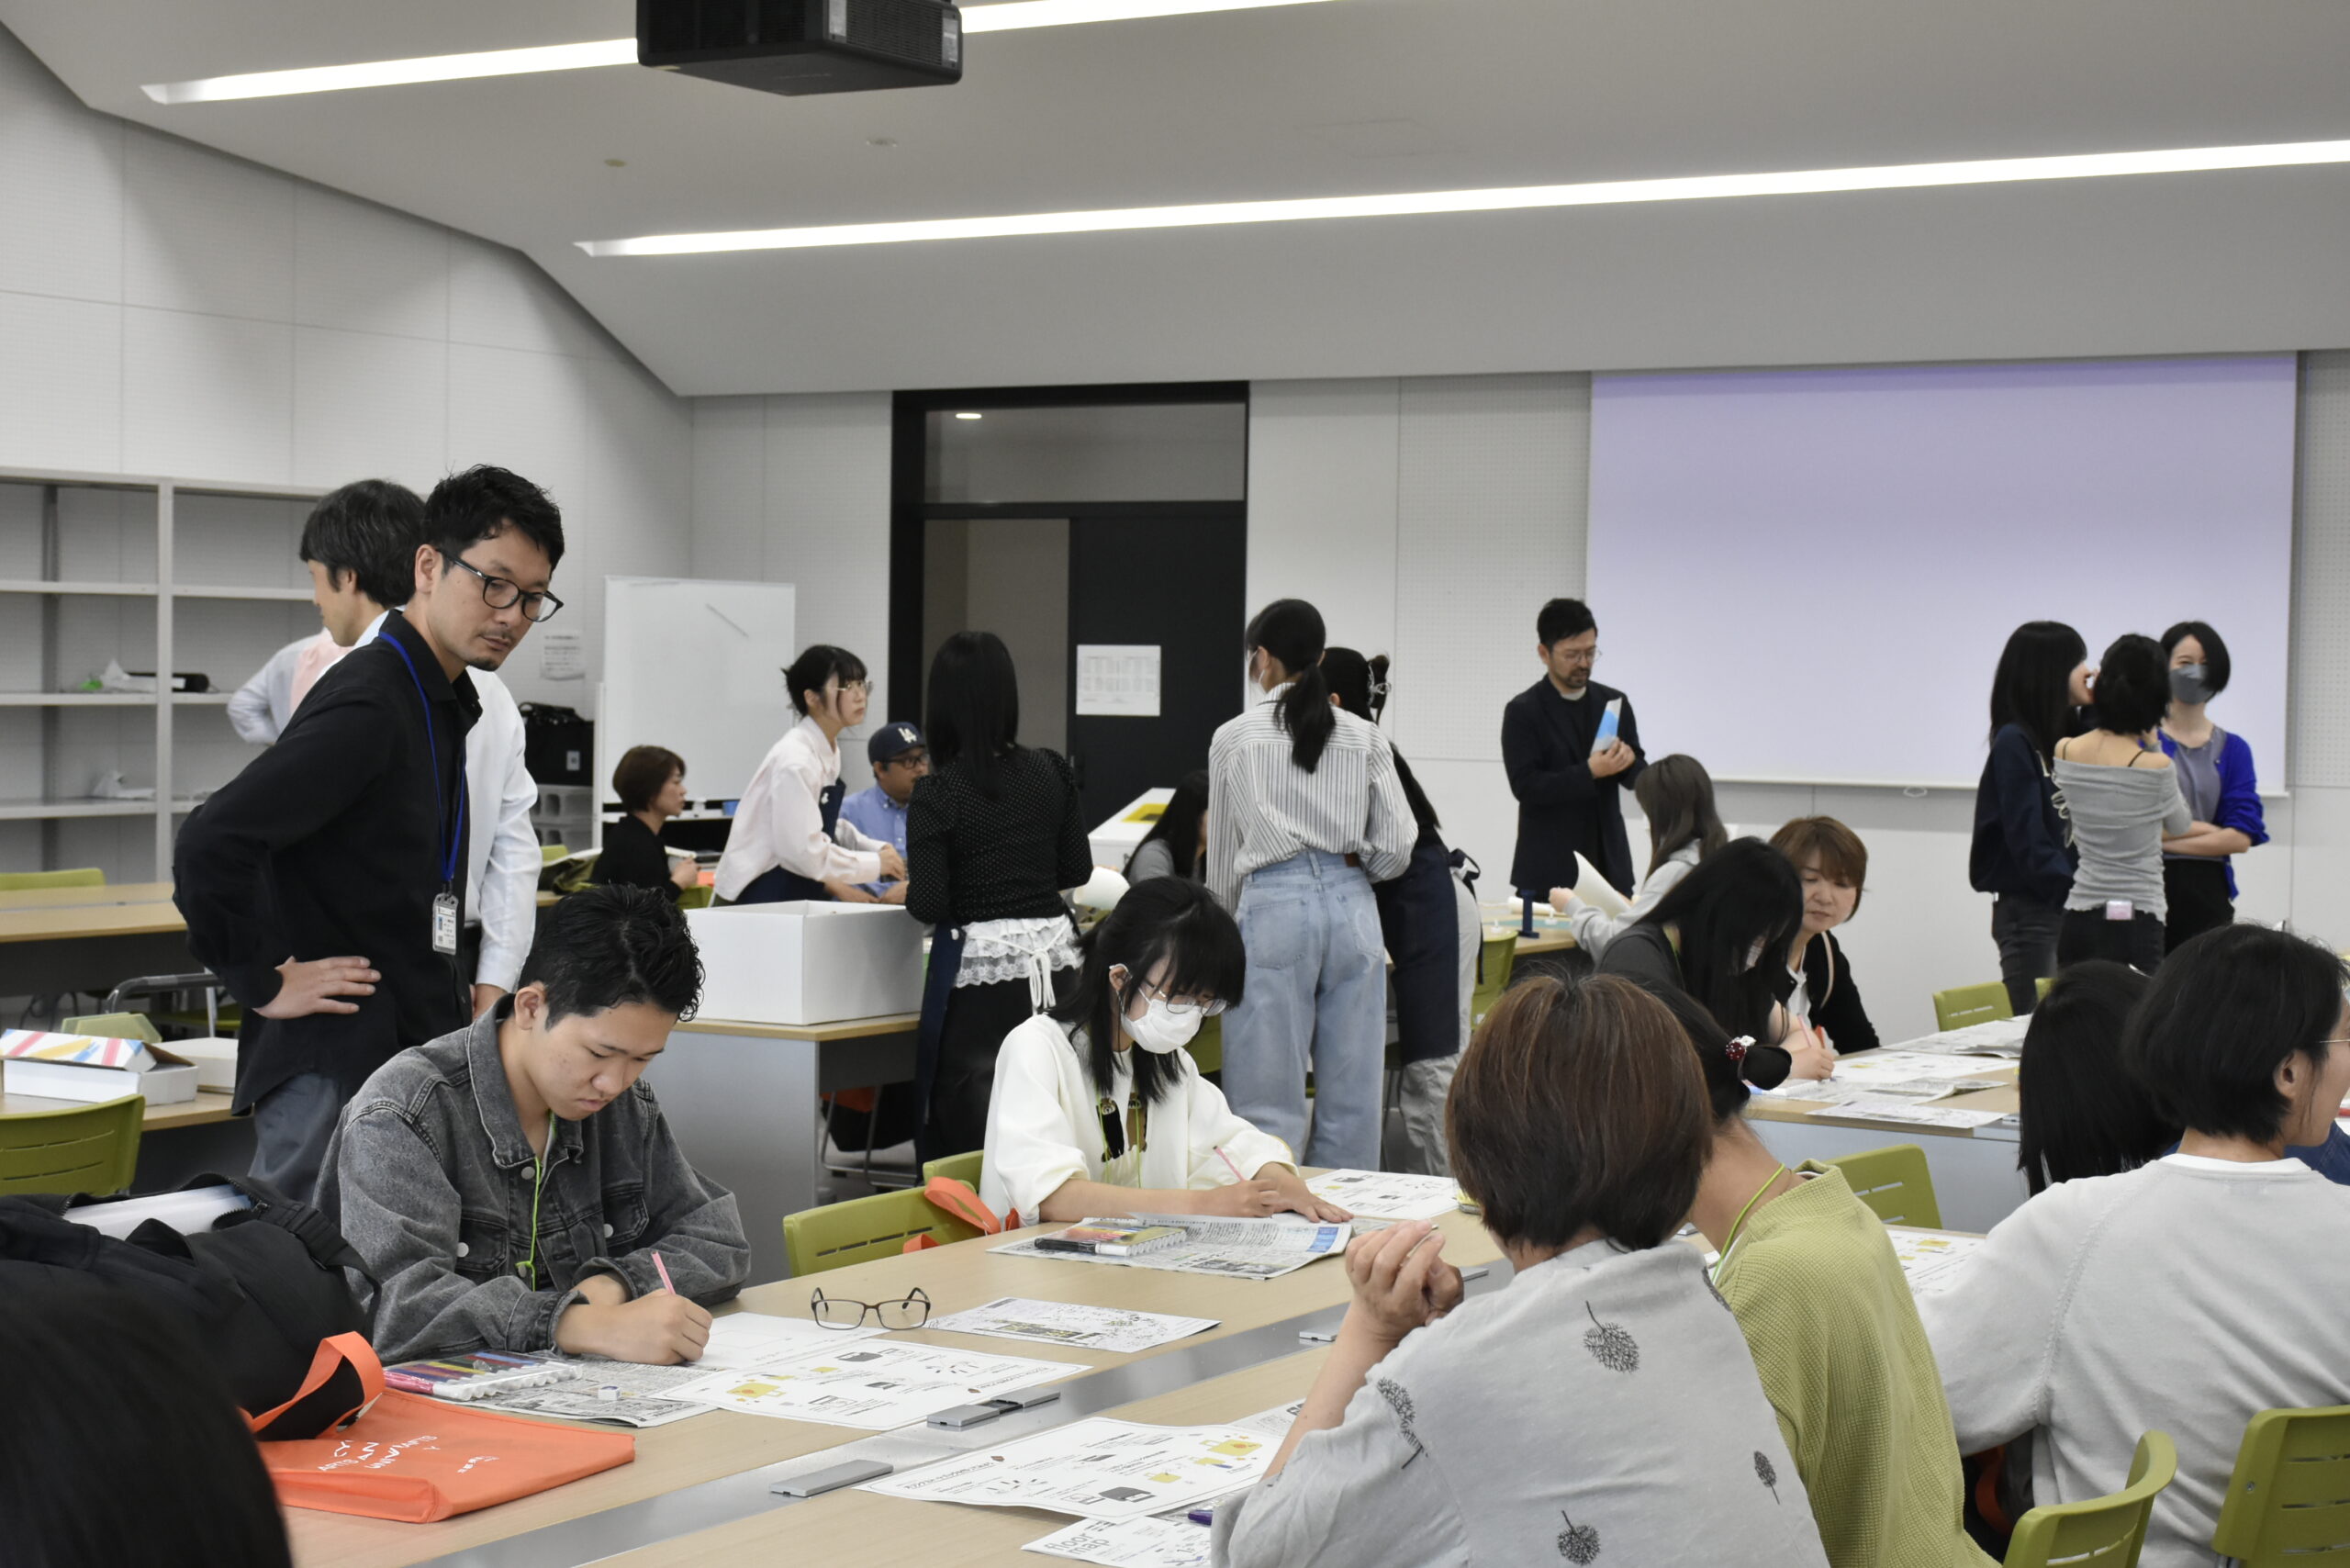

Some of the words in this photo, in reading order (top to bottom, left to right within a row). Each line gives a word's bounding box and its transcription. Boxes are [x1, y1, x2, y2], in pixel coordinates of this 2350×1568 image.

[897, 727, 918, 744] LA
[1045, 1533, 1093, 1551] floor
[1069, 1539, 1110, 1555] map
